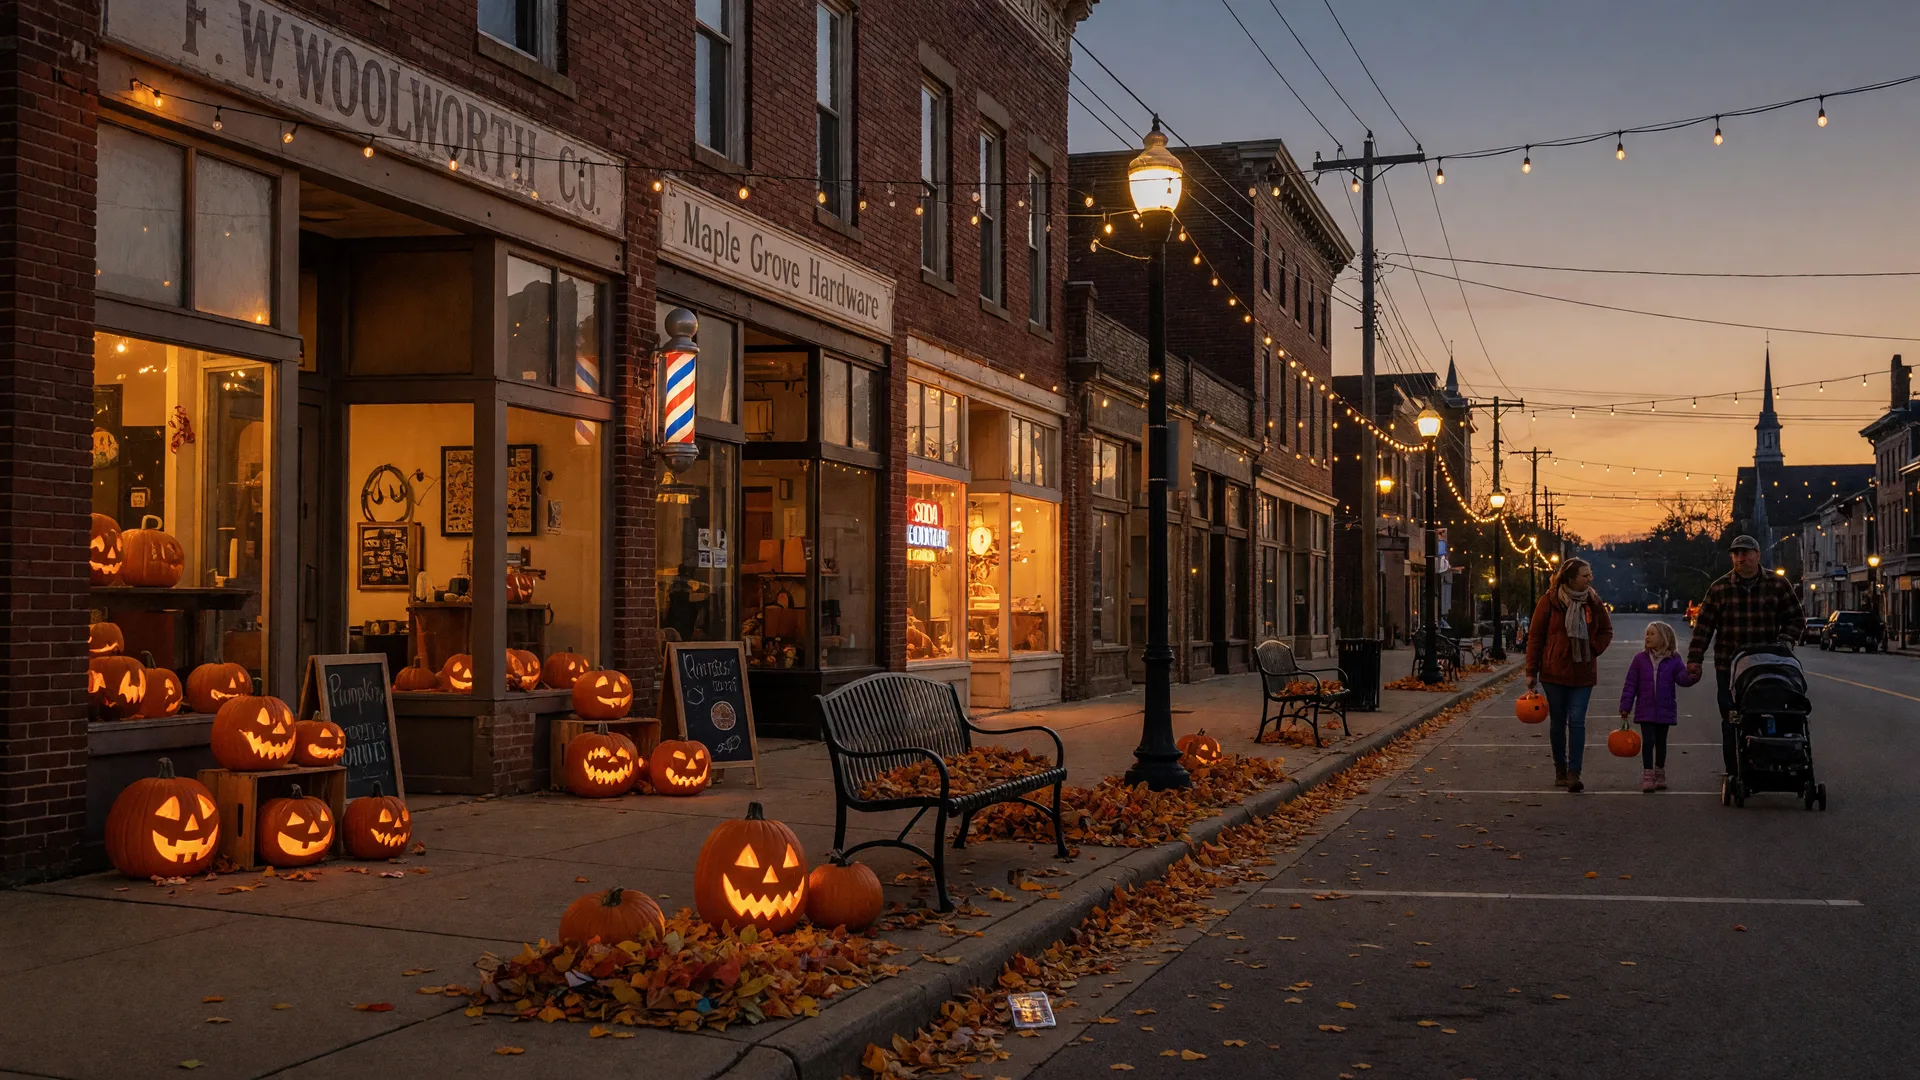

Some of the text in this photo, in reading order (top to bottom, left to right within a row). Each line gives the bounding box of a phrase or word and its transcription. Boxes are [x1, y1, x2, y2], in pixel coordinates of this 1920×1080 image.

[182, 0, 224, 64] F.
[291, 24, 537, 191] WOOLWORTH
[559, 145, 601, 215] CO.
[683, 201, 879, 321] Maple Grove Hardware
[914, 502, 938, 526] SODA
